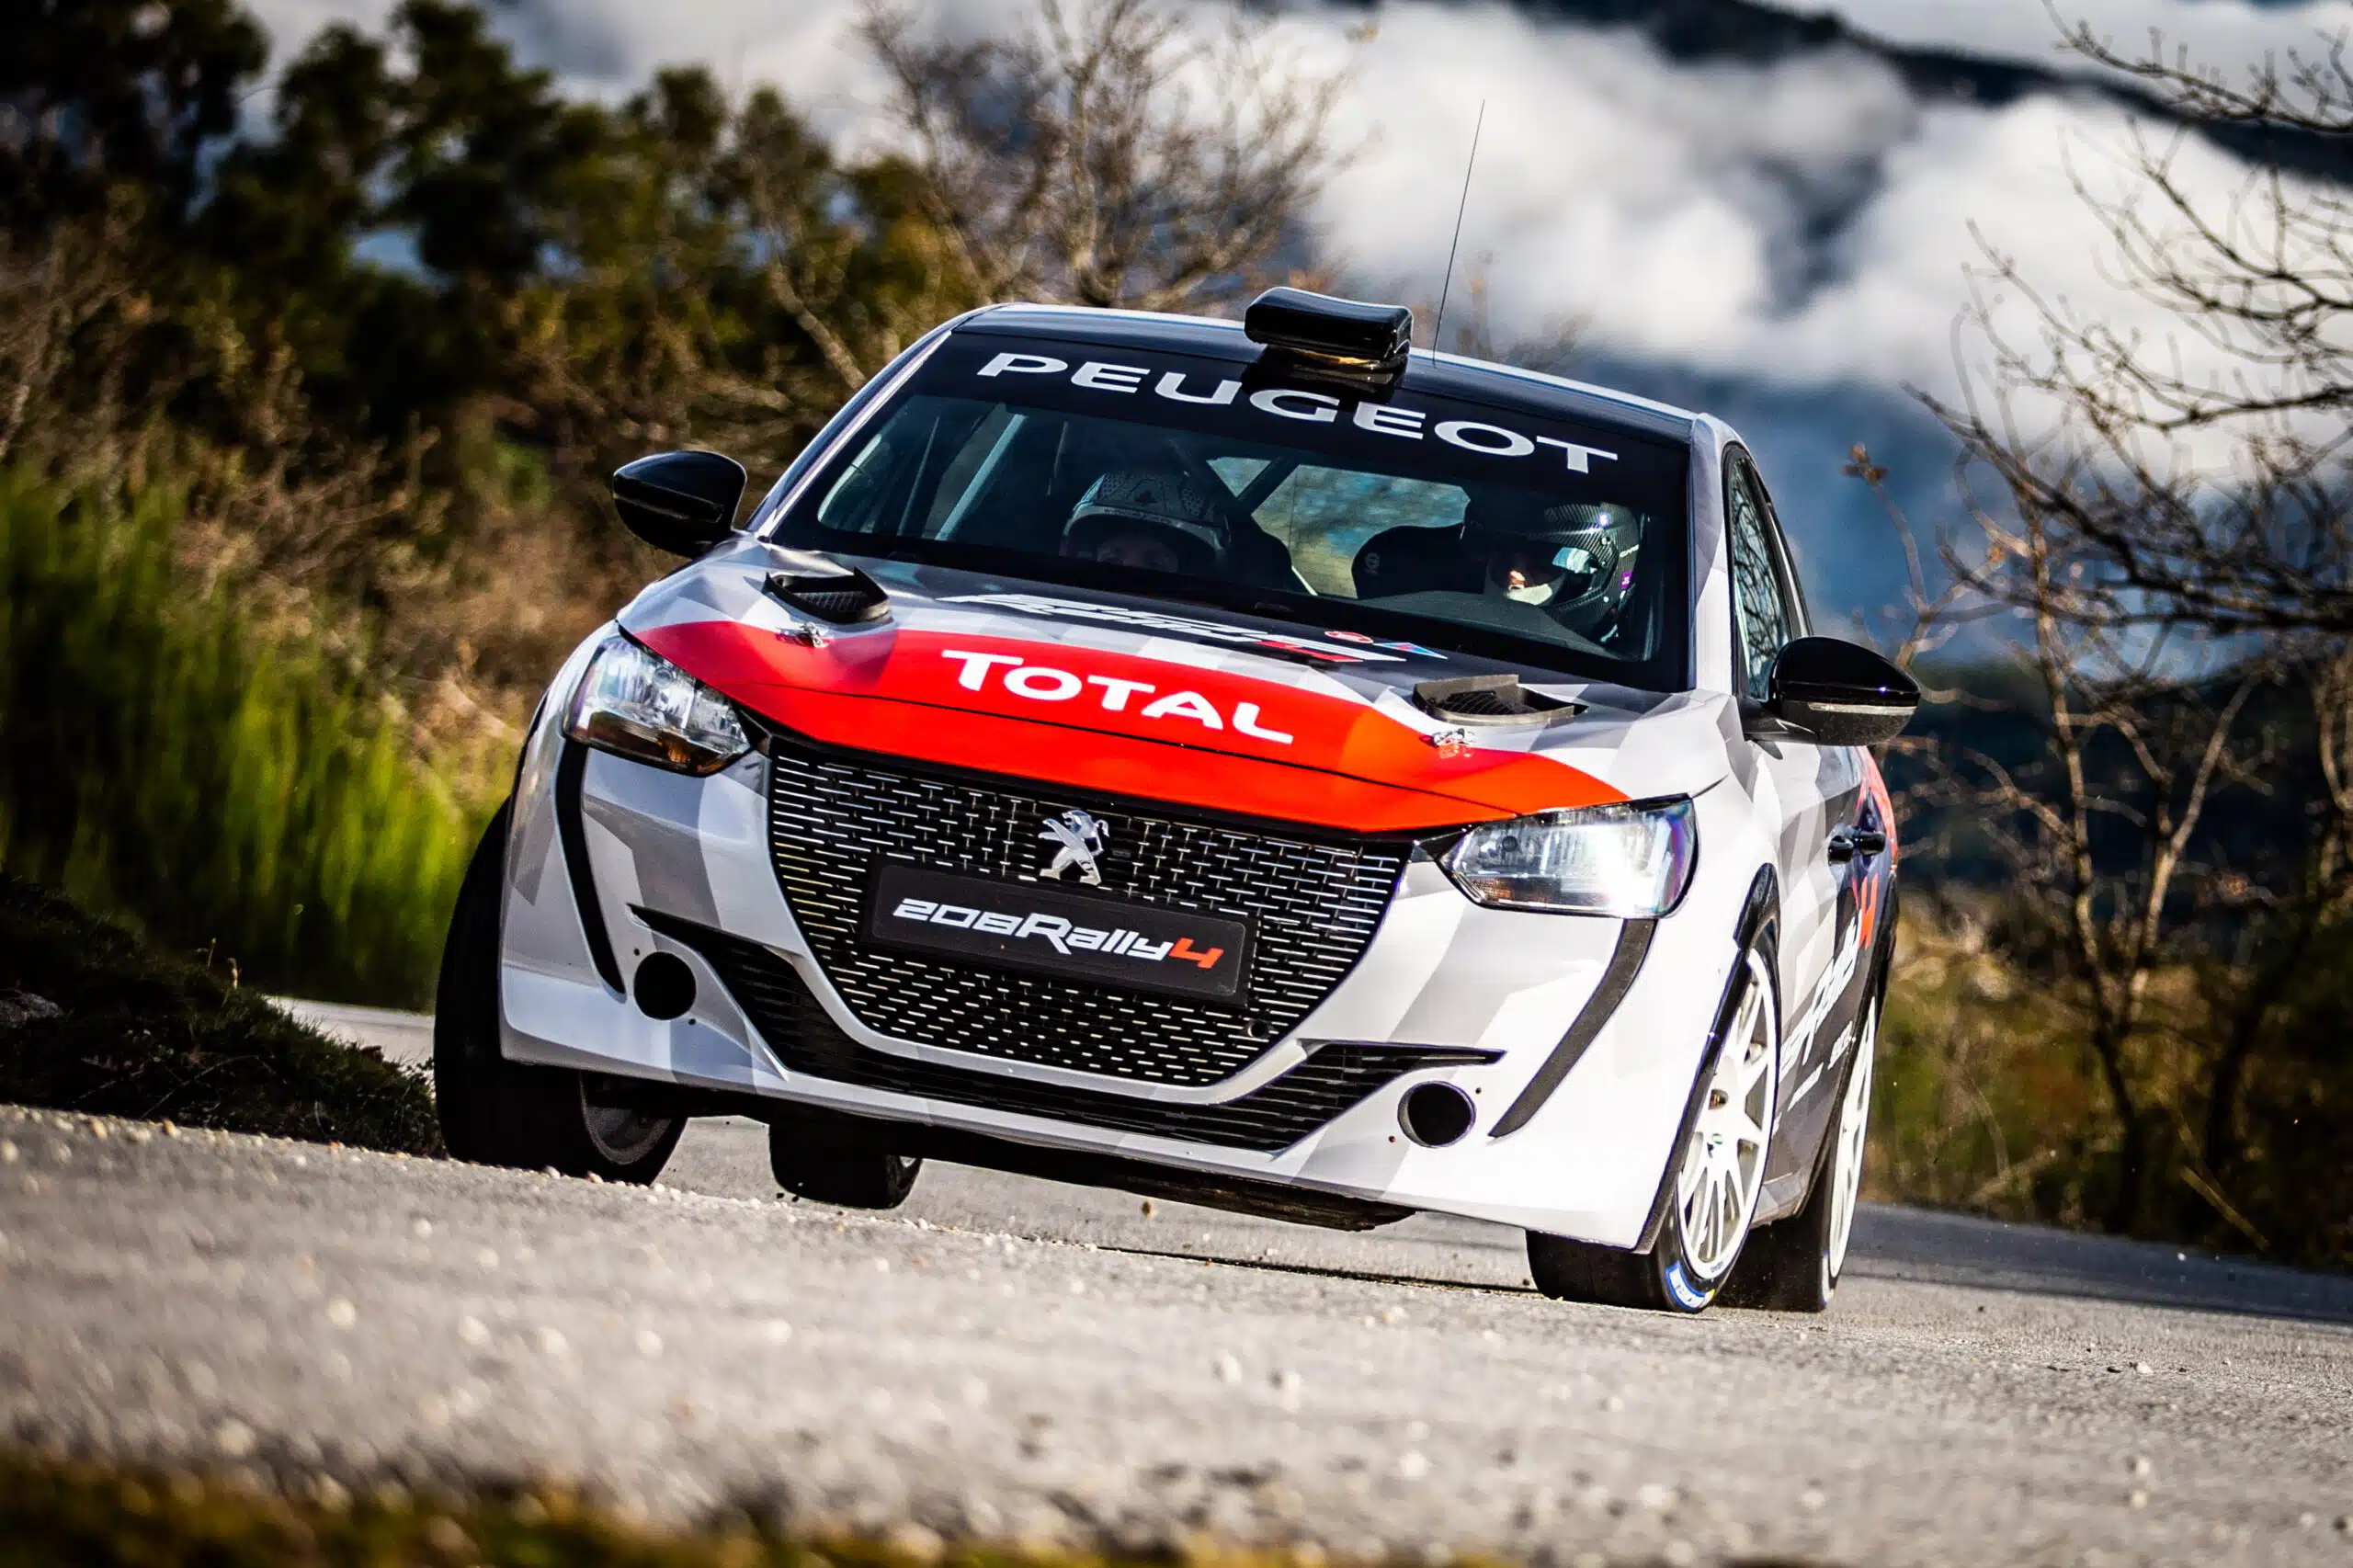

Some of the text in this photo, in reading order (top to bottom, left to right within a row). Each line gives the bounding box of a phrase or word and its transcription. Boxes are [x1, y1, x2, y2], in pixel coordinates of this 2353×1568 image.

[977, 352, 1619, 474] PEUGEOT
[941, 649, 1294, 744] TOTAL
[892, 897, 1224, 970] 208Rally4
